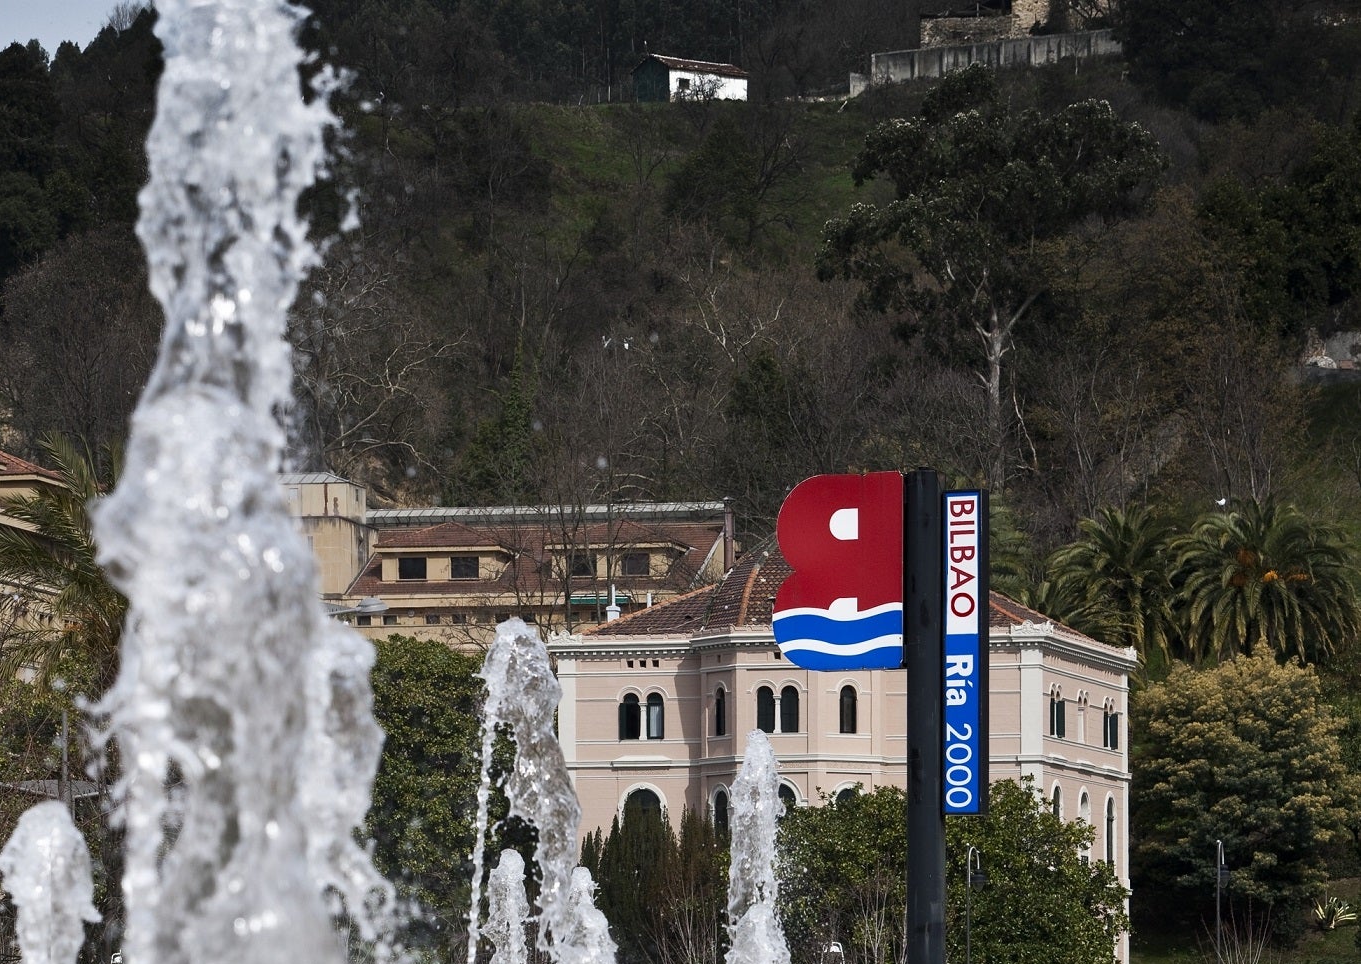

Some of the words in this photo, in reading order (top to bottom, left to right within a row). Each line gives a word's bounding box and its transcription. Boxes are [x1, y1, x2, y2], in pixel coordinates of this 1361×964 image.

[950, 500, 976, 618] BILBAO
[945, 655, 974, 706] Ría
[945, 723, 973, 808] 2000
